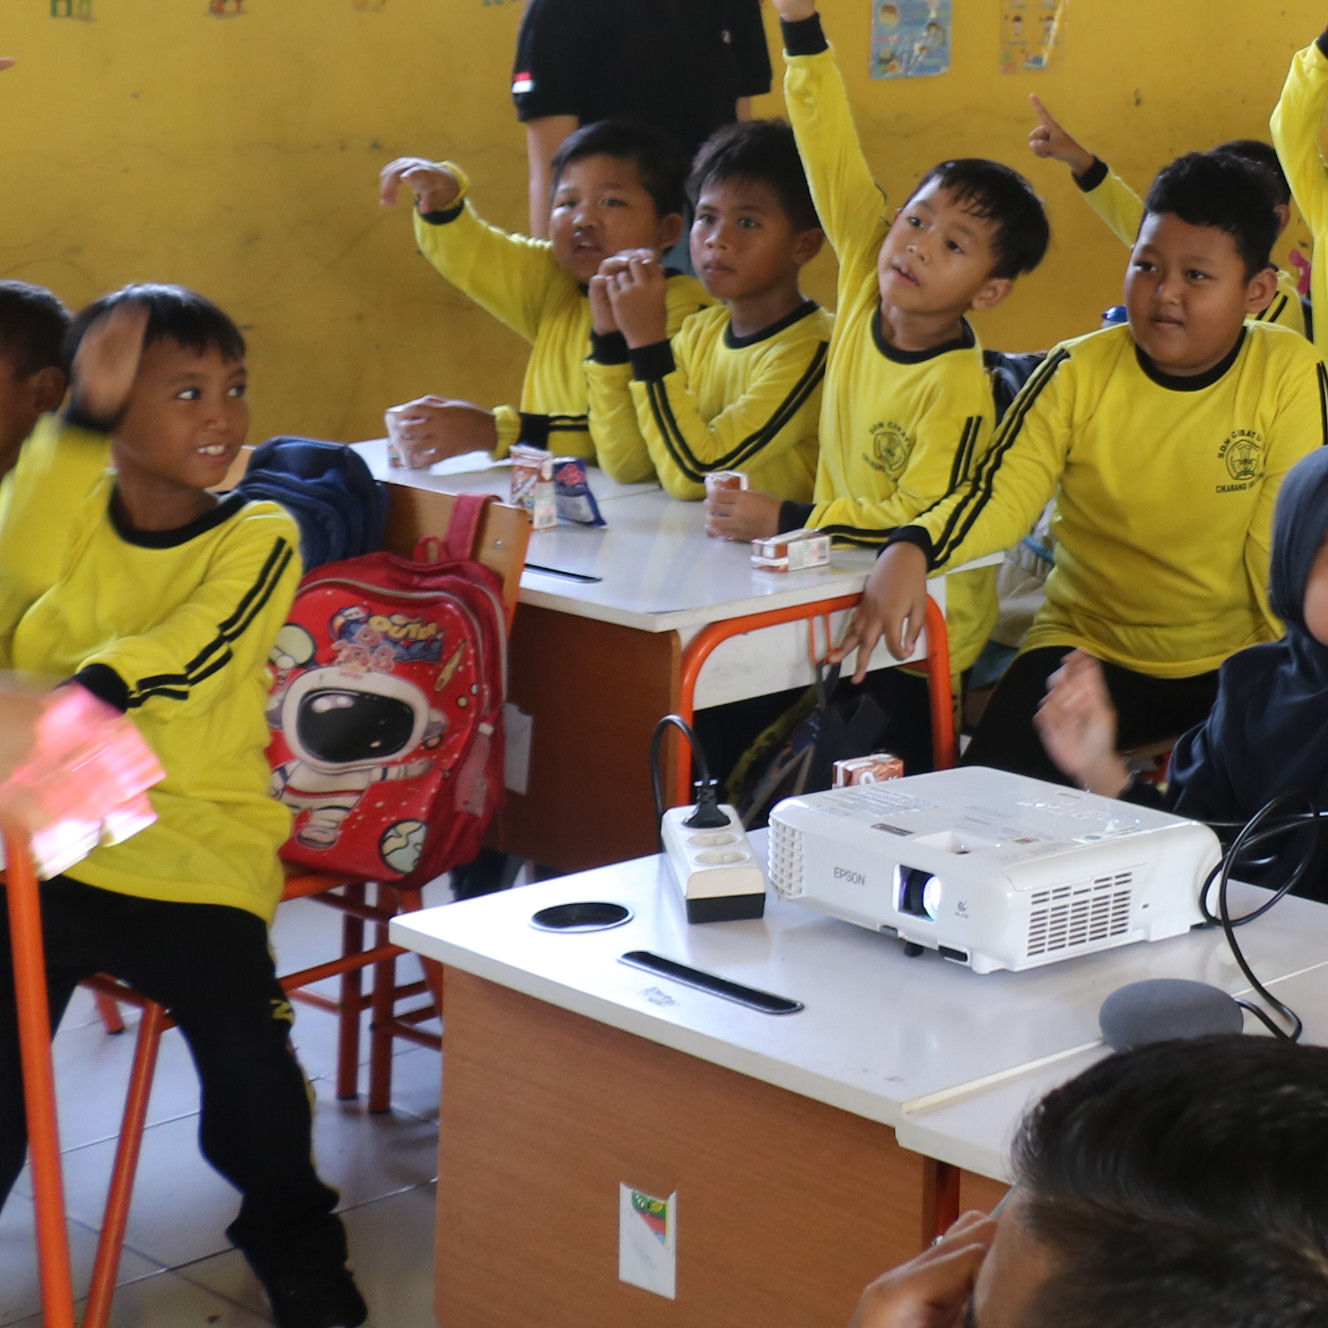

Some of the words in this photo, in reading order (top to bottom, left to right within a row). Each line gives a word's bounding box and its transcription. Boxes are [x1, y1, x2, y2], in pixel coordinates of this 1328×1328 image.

[1217, 438, 1231, 459] SDN
[1231, 429, 1262, 442] CIBATU
[833, 867, 866, 886] EPSON
